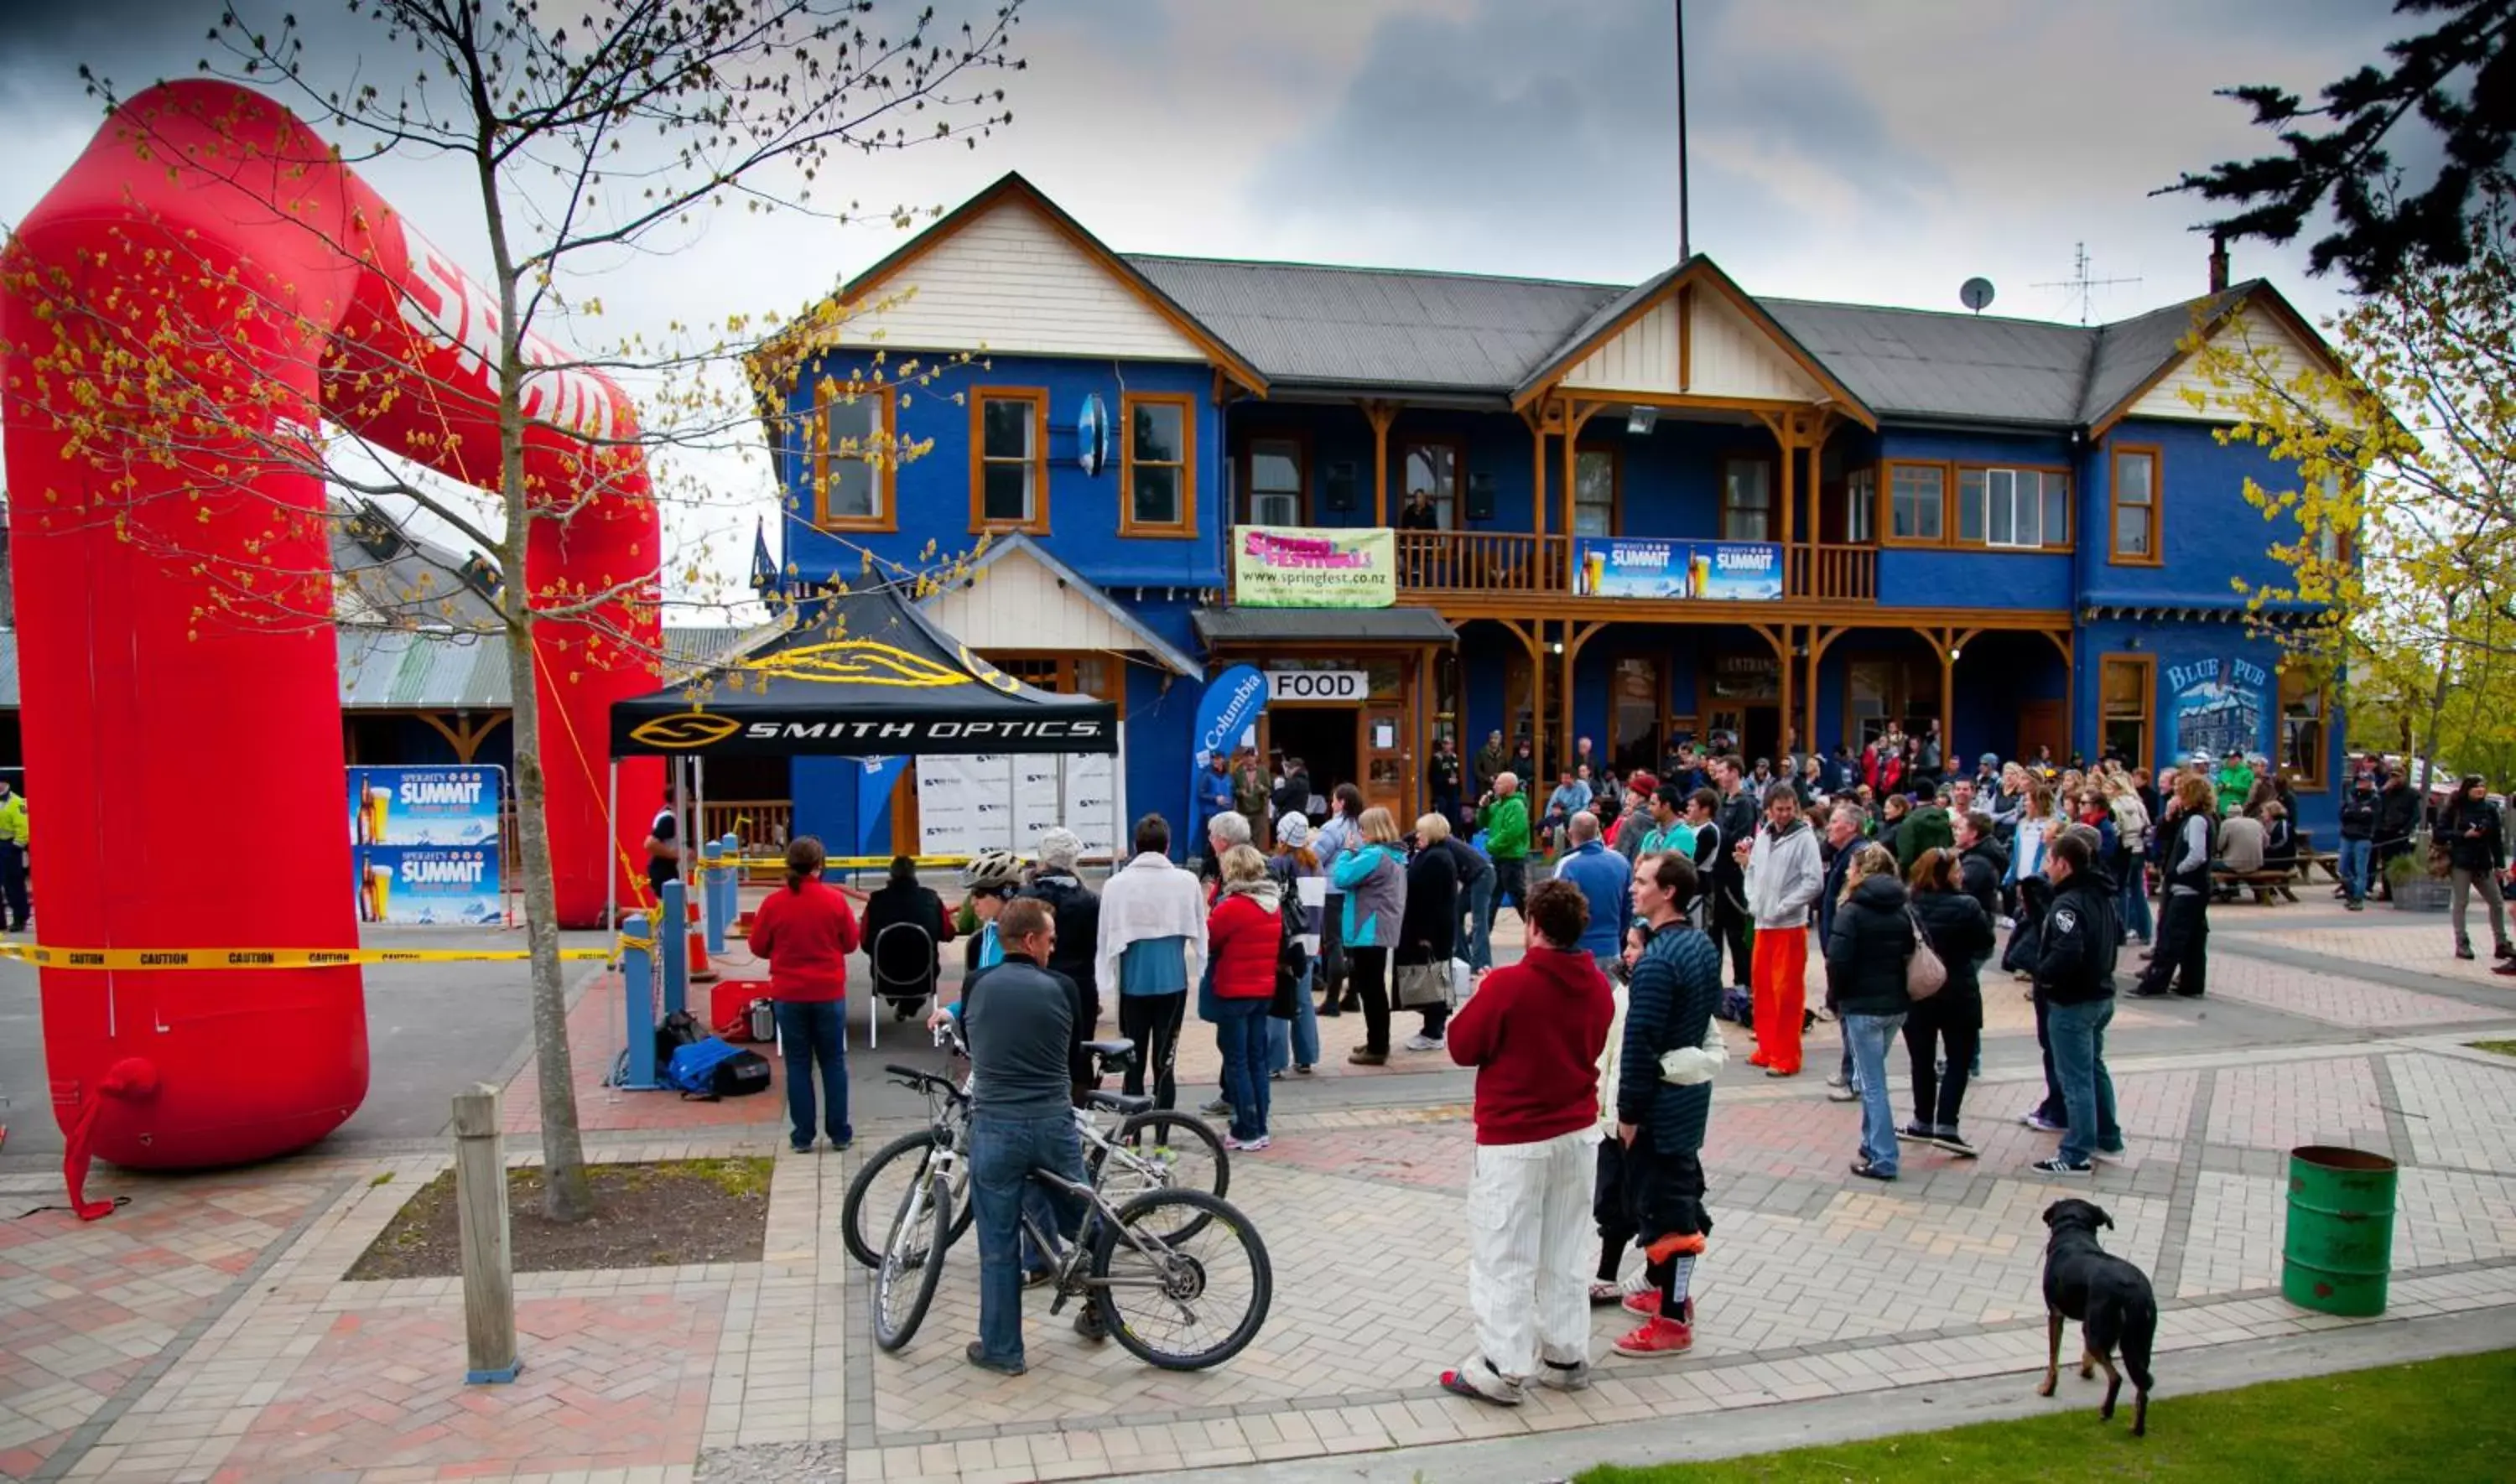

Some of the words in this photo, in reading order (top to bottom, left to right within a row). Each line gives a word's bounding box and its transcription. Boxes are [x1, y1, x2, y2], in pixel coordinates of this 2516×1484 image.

[1611, 550, 1671, 567] SUMMIT
[1717, 553, 1774, 570] SUMMIT
[1242, 571, 1386, 588] www.springfest.co.nz
[2167, 657, 2219, 693] BLUE
[2234, 657, 2266, 687] PUB
[1277, 674, 1354, 697] FOOD
[1205, 672, 1262, 750] Columbia
[745, 722, 916, 739] SMITH
[400, 782, 482, 804] SUMMIT
[401, 860, 485, 883] SUMMIT
[70, 953, 105, 964] CAUTION
[140, 952, 189, 965] CAUTION
[228, 952, 274, 963] CAUTION
[308, 952, 350, 963] CAUTION
